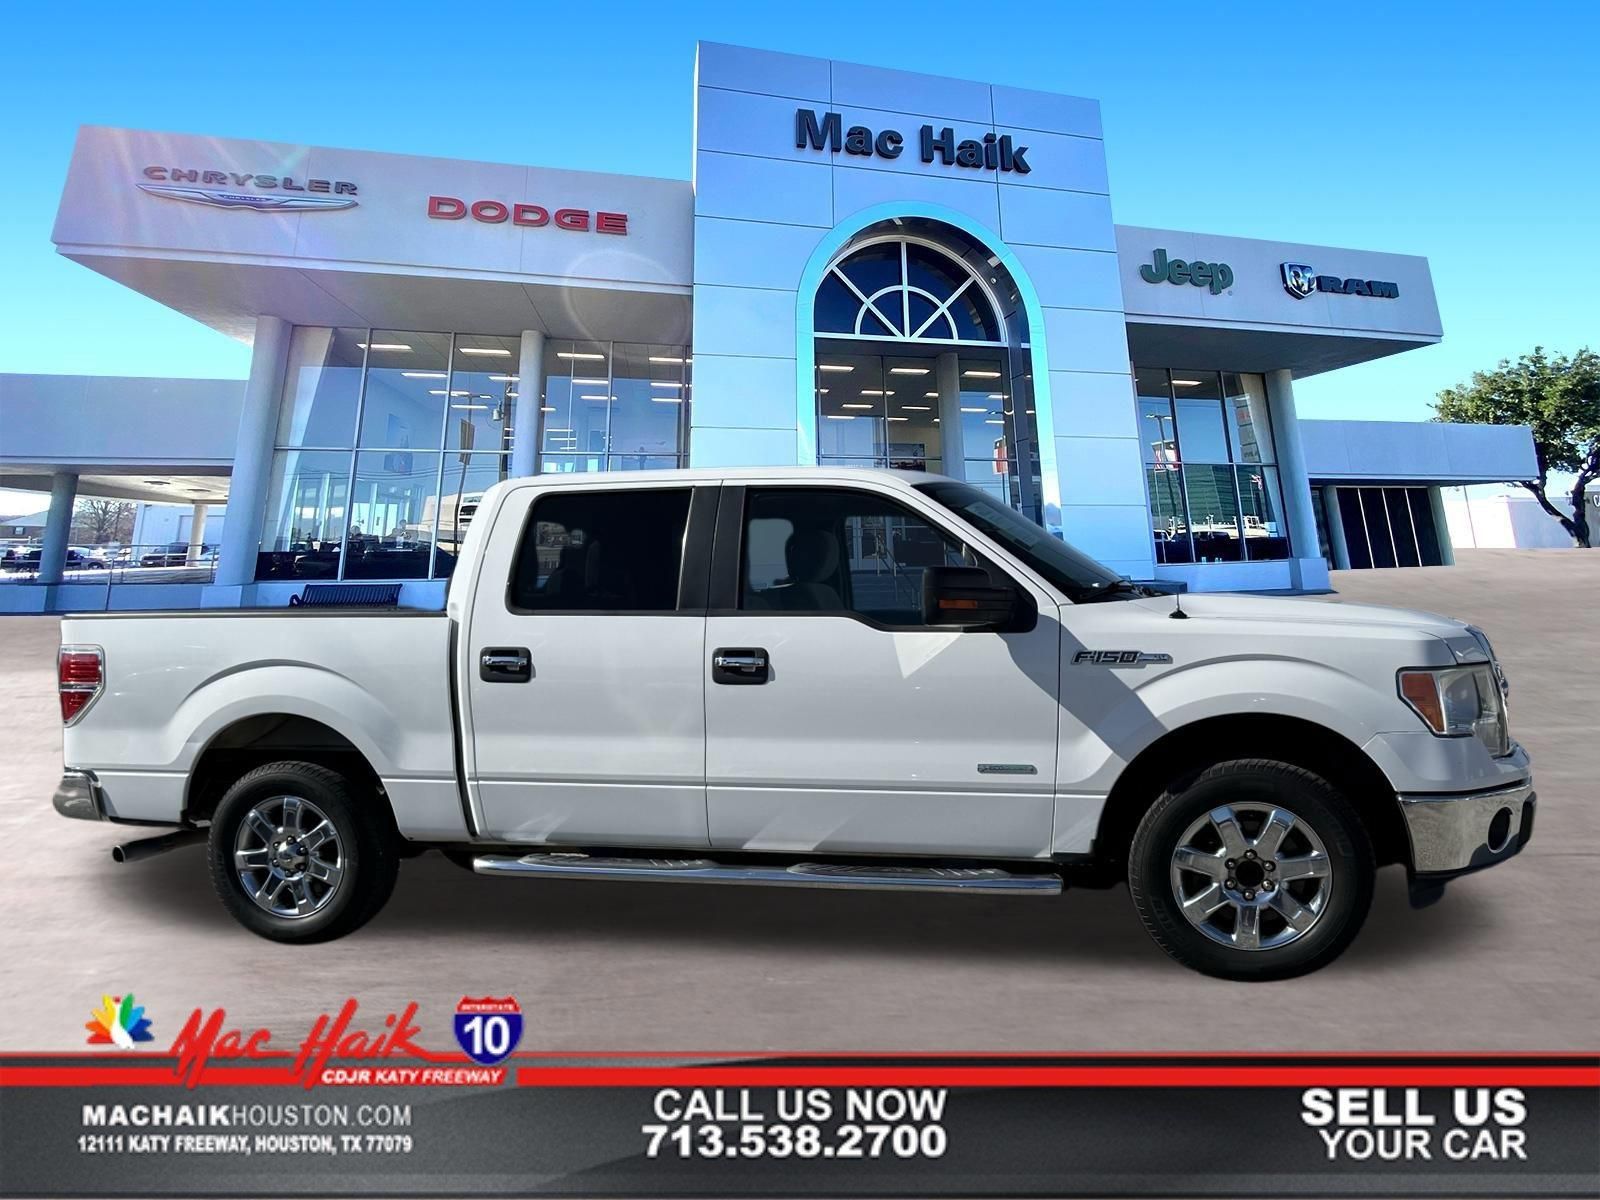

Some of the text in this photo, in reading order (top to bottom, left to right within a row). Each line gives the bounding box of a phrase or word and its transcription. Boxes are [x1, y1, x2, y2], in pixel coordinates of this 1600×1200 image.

[795, 108, 1032, 174] Mac Haik
[143, 166, 358, 196] CHRYSLER
[428, 196, 628, 236] DODGE
[1140, 248, 1234, 295] Jeep
[1316, 275, 1399, 299] RAM
